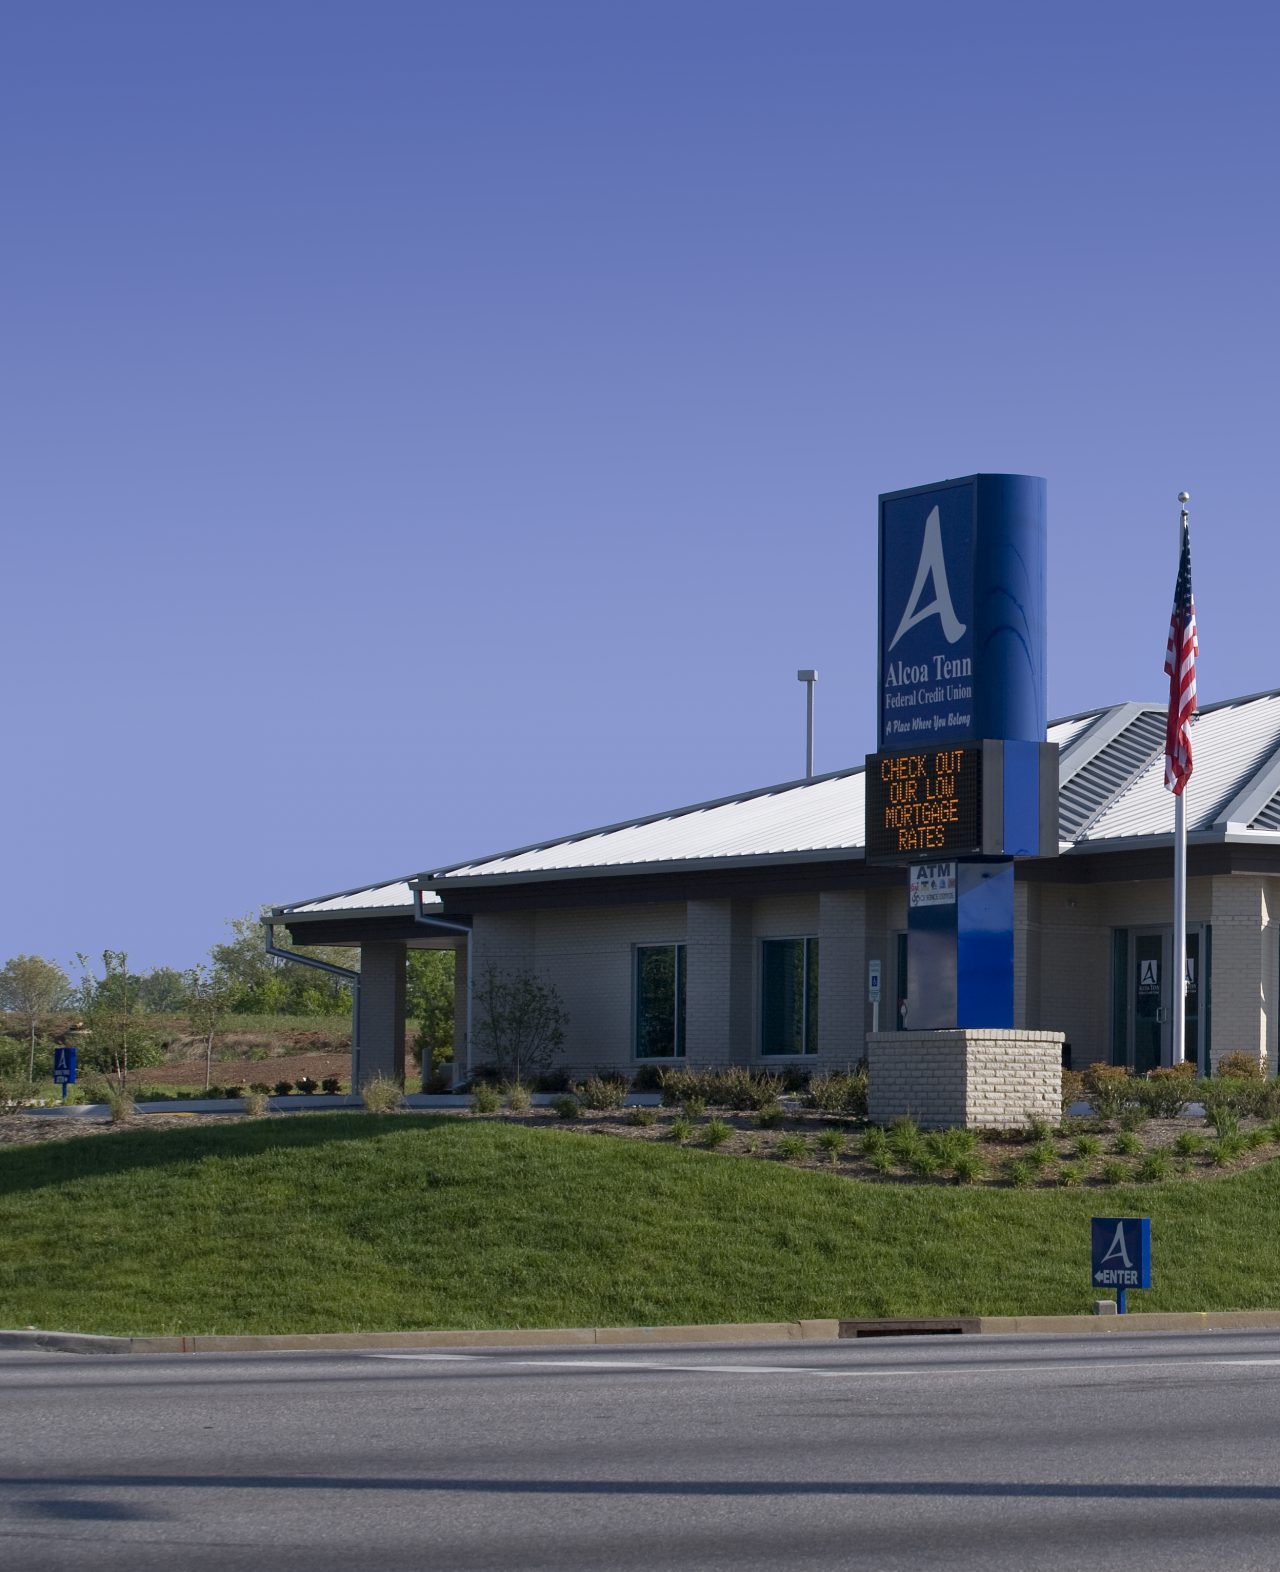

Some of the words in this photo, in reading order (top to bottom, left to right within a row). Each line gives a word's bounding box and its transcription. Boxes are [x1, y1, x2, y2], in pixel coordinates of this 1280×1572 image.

[889, 504, 967, 652] A
[885, 660, 929, 688] Alcoa
[933, 654, 972, 681] Tenn
[886, 690, 917, 709] Federal
[918, 687, 945, 705] Credit
[946, 683, 972, 701] Union
[886, 720, 892, 736] A
[893, 719, 911, 733] Place
[912, 716, 932, 731] Where
[933, 714, 946, 731] You
[947, 712, 971, 728] Belong
[881, 754, 927, 781] CHECK
[936, 750, 964, 774] OUT
[890, 781, 918, 804] OUR
[926, 775, 955, 799] LOW
[886, 799, 959, 829] MORTGAGE
[899, 825, 945, 851] RATES
[917, 863, 951, 880] ATM
[1100, 1220, 1133, 1268] A
[1103, 1269, 1138, 1285] ENTER
